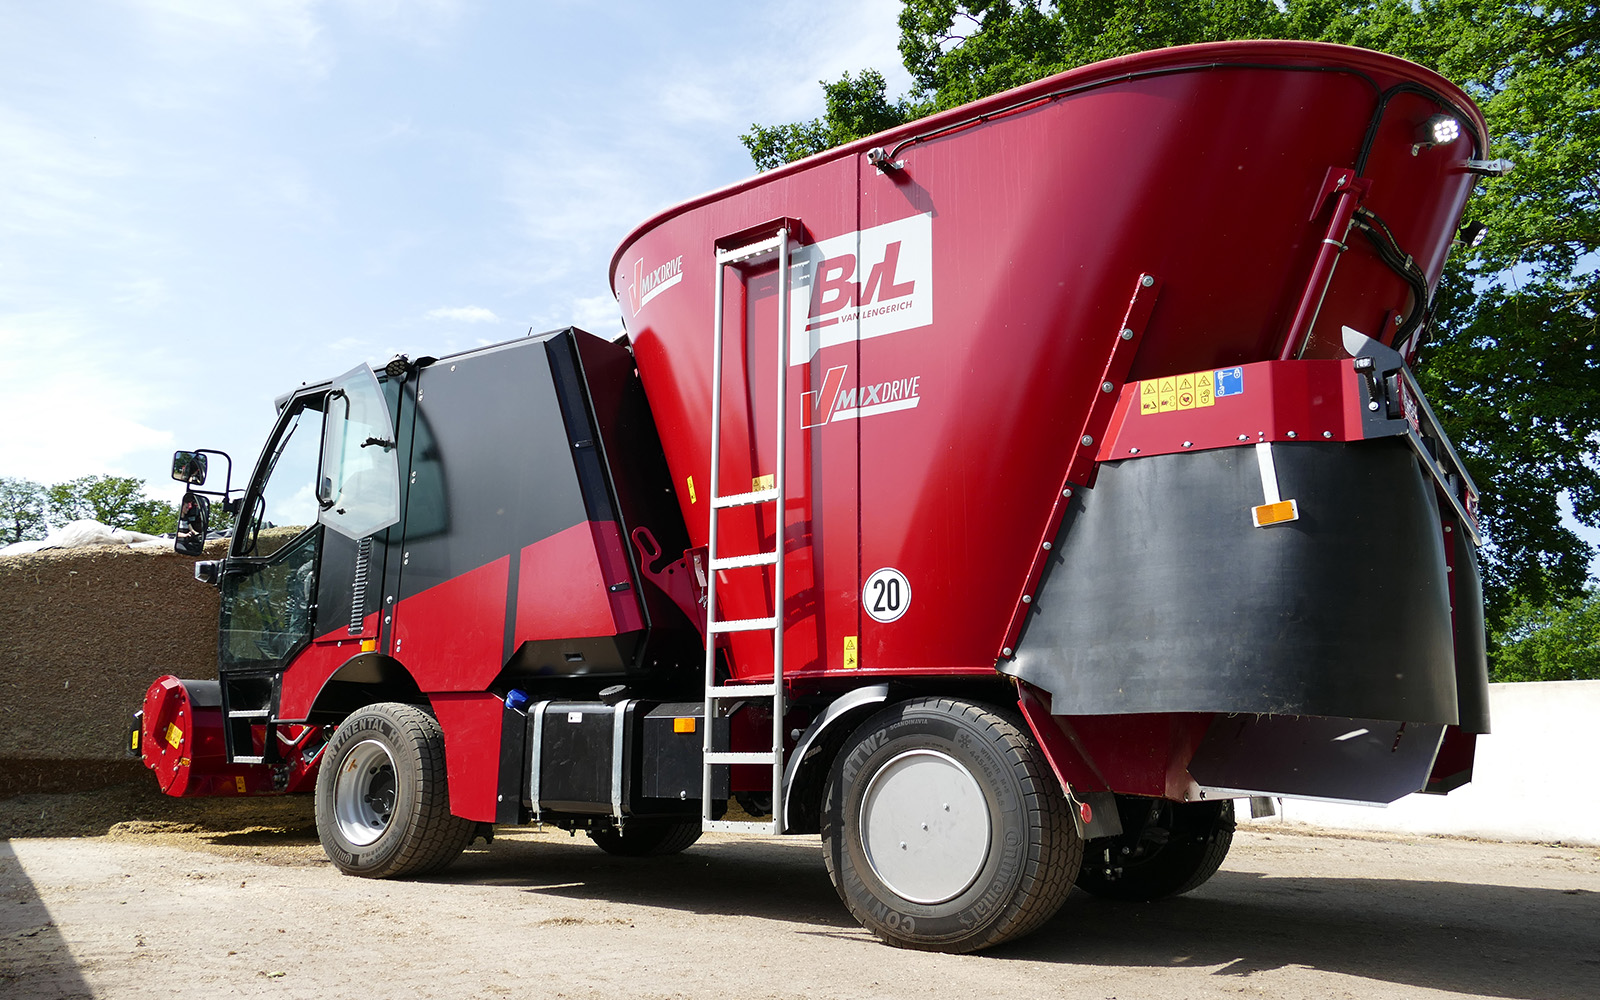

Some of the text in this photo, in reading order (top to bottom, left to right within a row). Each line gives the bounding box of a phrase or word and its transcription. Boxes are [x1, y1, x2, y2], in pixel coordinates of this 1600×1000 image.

[841, 300, 913, 323] VAN LENGERICH
[873, 578, 900, 612] 20
[889, 719, 928, 730] SCANDINAVIA
[321, 717, 385, 779] CONTINENTAL
[842, 728, 889, 783] HTW2
[980, 747, 1000, 775] WINTER
[841, 799, 915, 934] CONTINE
[969, 827, 1022, 922] Continental
